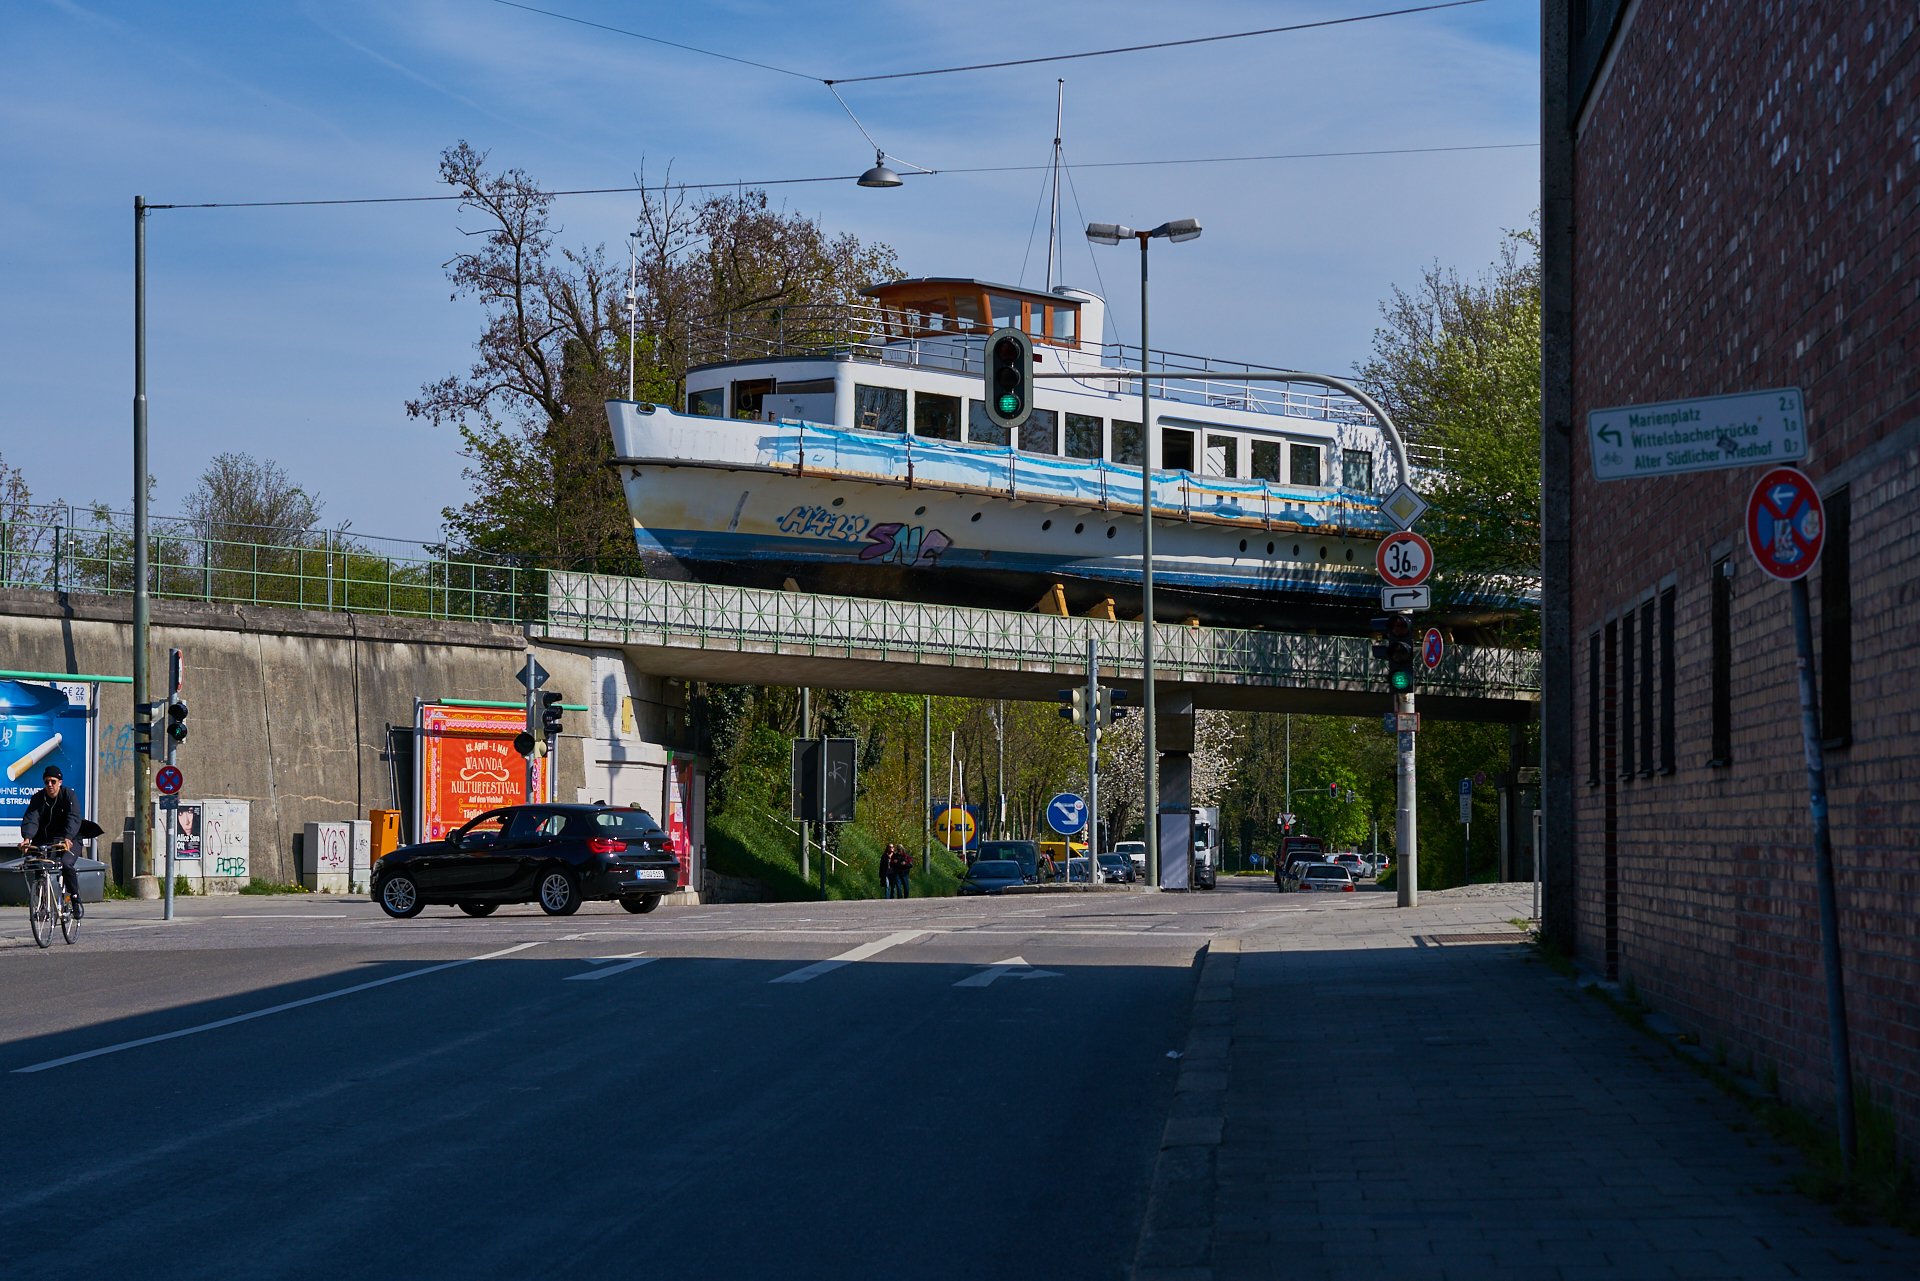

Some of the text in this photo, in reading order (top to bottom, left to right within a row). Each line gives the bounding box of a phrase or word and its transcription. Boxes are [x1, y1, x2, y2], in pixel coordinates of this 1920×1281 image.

[1629, 408, 1701, 428] Marienplatz
[1632, 422, 1758, 448] Wittelsbacherbrücke
[1635, 455, 1662, 469] Alter
[1666, 449, 1720, 466] Südlicher
[1389, 544, 1411, 576] 3,6
[75, 686, 85, 696] 22
[474, 740, 489, 752] April
[465, 757, 504, 770] WANNDA
[451, 780, 521, 795] KULTURFESTIVAL
[469, 795, 477, 803] Auf
[176, 834, 200, 842] Alice Sara
[176, 842, 185, 850] Ott
